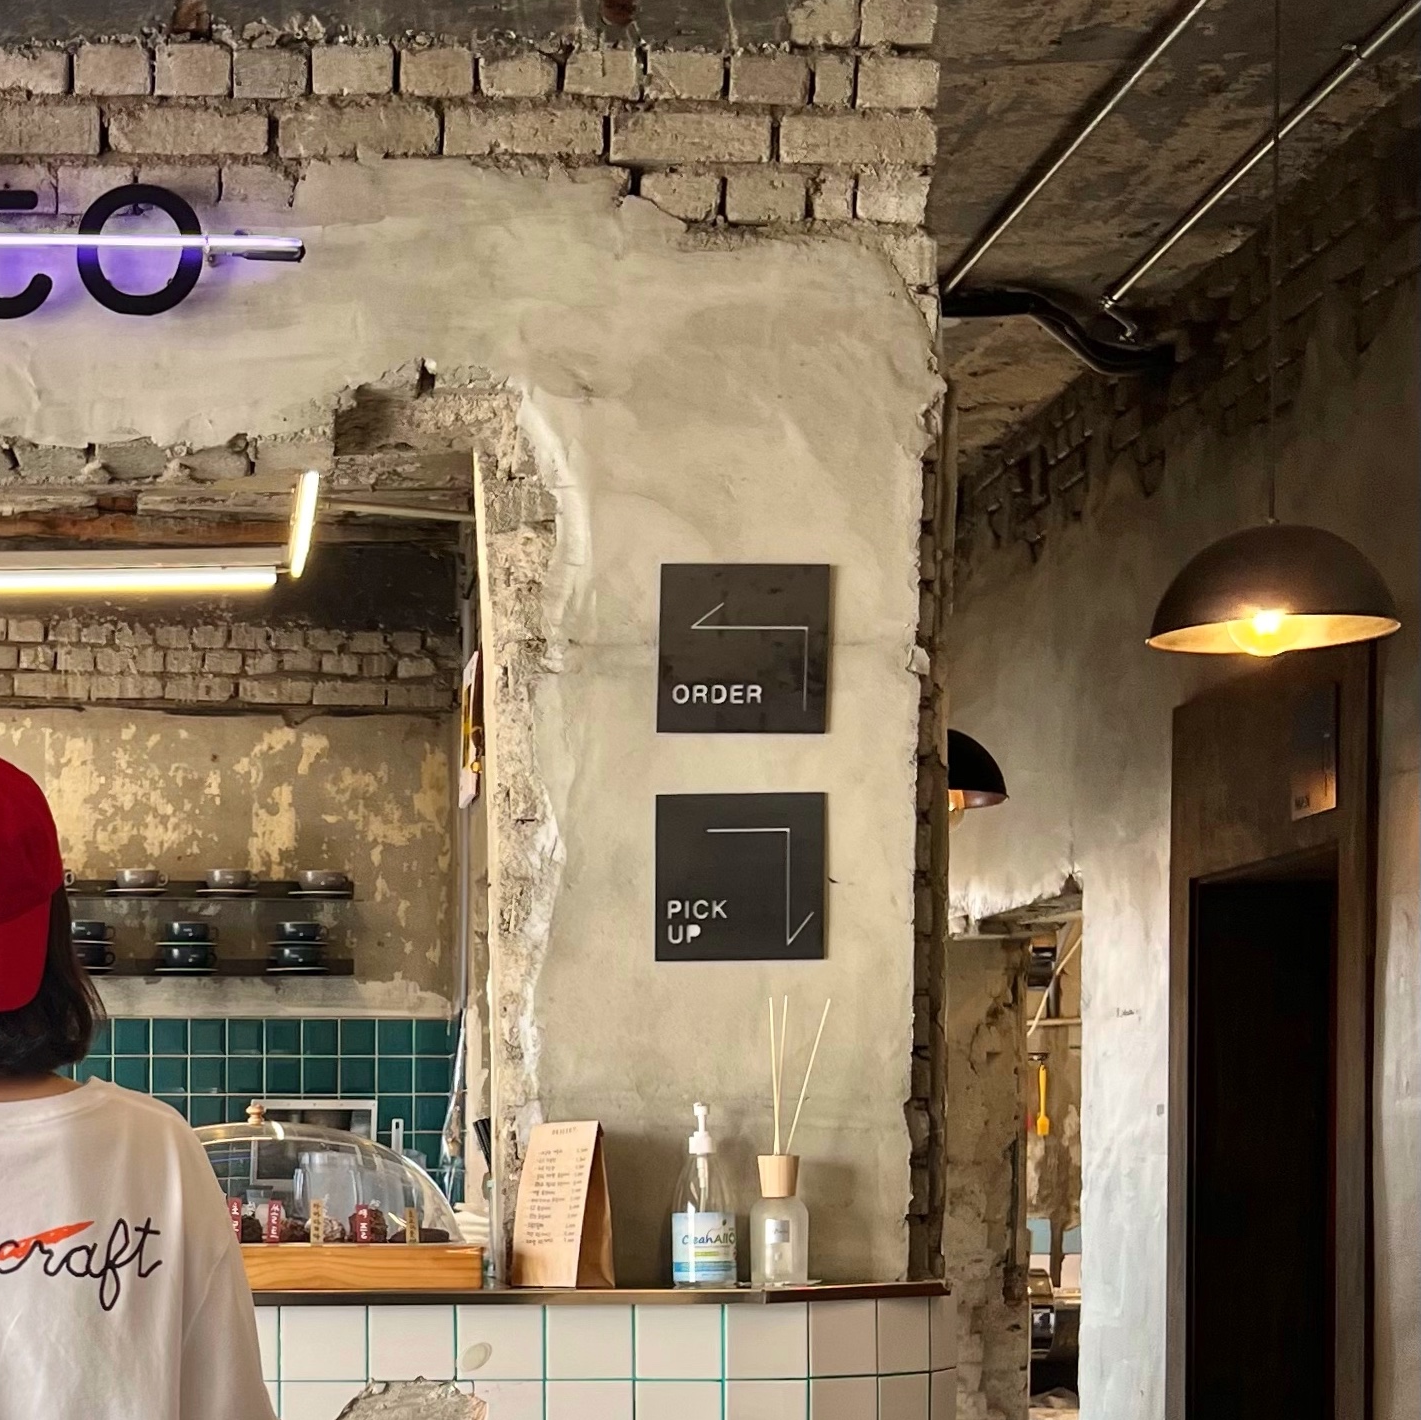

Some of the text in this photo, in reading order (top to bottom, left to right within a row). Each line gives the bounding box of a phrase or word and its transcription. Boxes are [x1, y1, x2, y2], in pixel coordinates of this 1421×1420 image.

[672, 684, 763, 704] ORDER
[667, 899, 729, 920] PICK
[667, 924, 702, 944] UP
